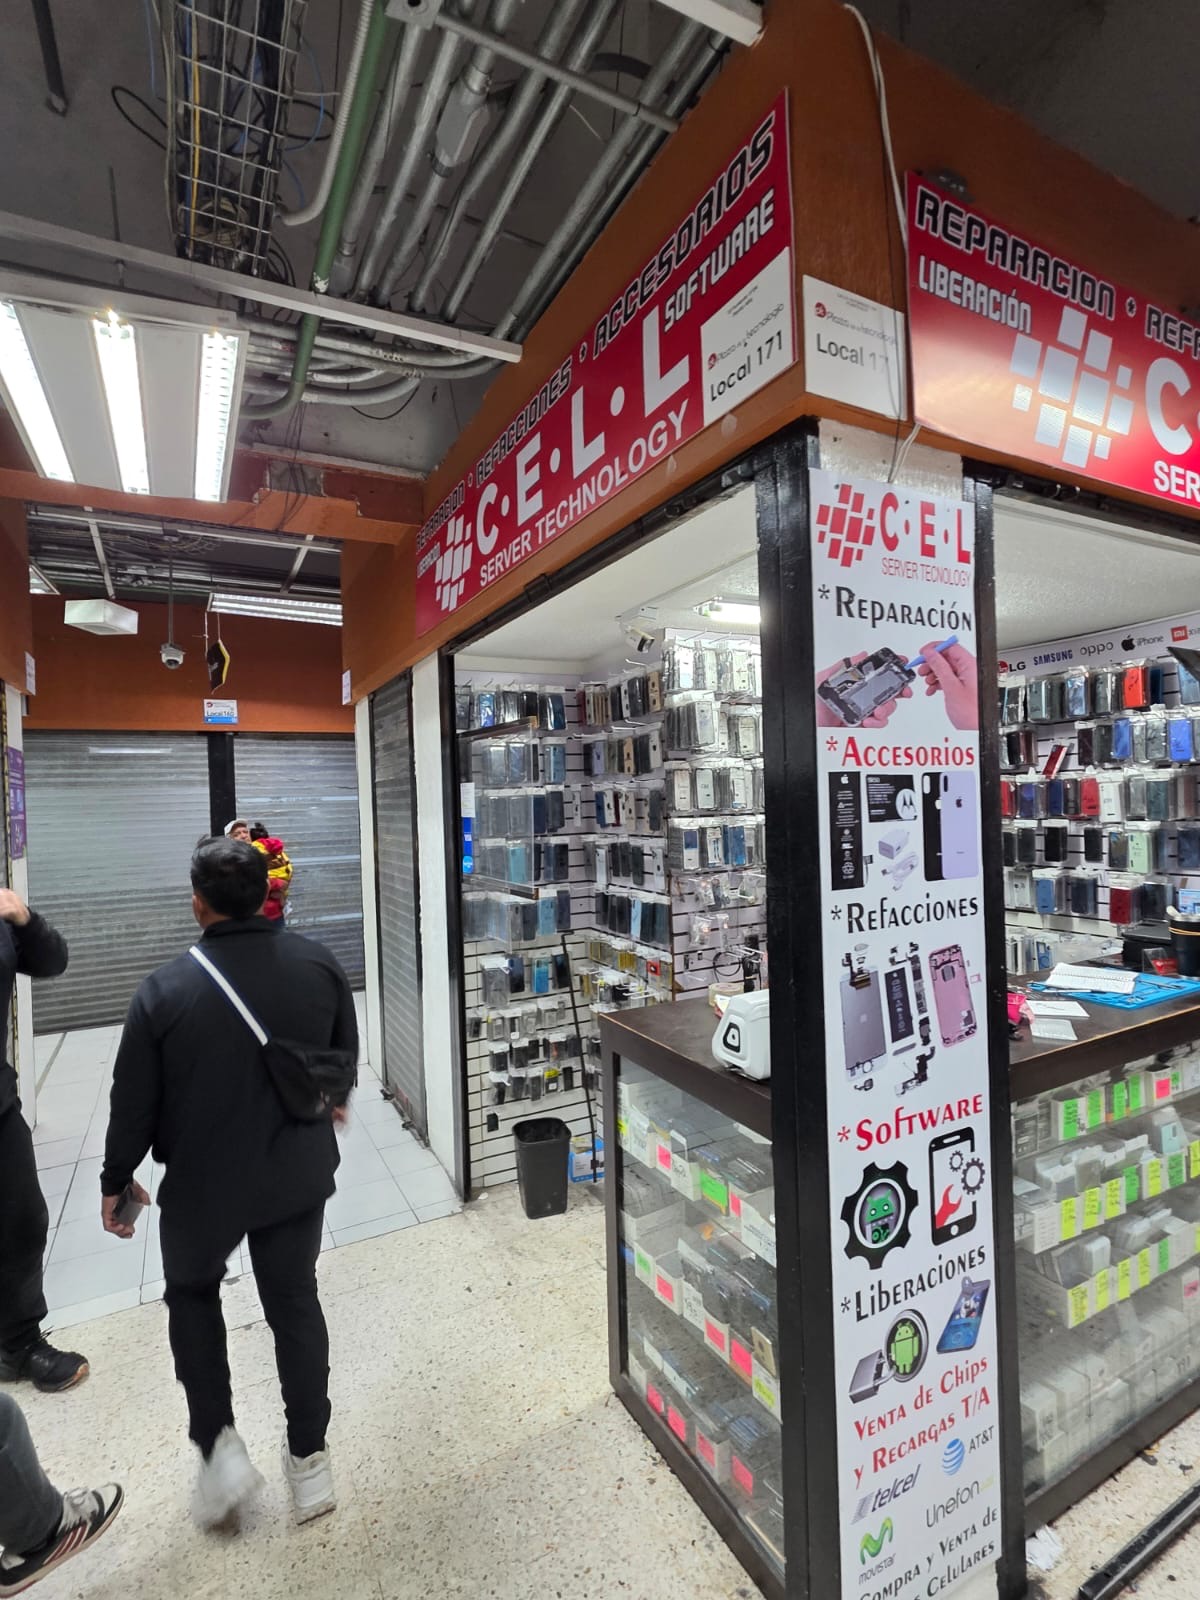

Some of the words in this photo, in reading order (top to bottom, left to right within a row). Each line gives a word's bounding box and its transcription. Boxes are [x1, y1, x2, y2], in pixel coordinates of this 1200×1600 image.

[593, 110, 776, 360] ACCESORIOS
[664, 186, 775, 332] SOFTWARE
[916, 185, 1115, 320] REPARACION
[918, 255, 1032, 333] LIBERACIÓN
[711, 355, 751, 401] Local
[757, 329, 783, 365] 171
[817, 333, 864, 366] Local
[476, 355, 573, 489] REFACCIONES
[480, 529, 533, 587] SERVER
[535, 398, 689, 544] TECHNOLOGY
[881, 557, 917, 579] SERVER
[1009, 661, 1026, 672] LG
[1033, 649, 1073, 666] SAMSUNG
[961, 1386, 990, 1418] T/A
[969, 1426, 995, 1453] AT&T
[871, 1464, 921, 1513] telcel
[926, 1480, 979, 1527] Unefon
[859, 1553, 896, 1585] movistar
